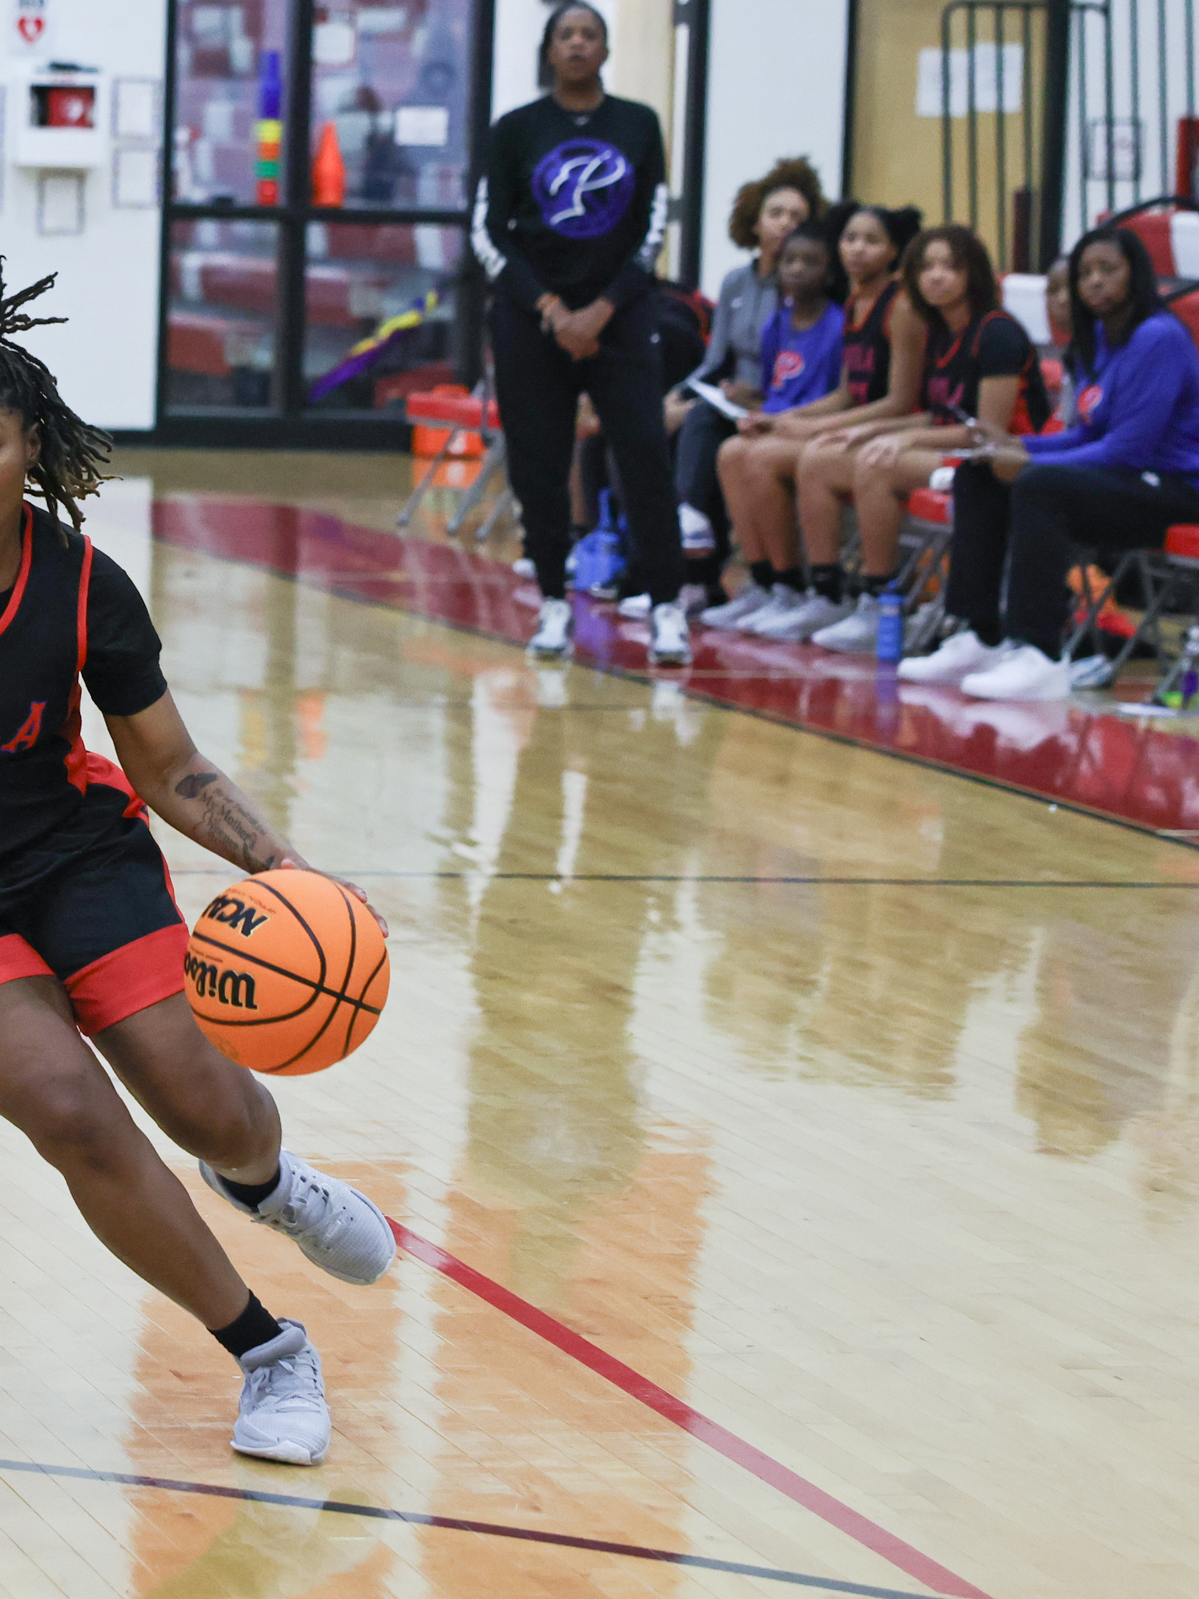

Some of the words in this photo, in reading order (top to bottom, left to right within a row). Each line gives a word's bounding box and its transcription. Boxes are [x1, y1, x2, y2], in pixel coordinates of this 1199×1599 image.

[548, 149, 626, 226] P
[772, 351, 805, 391] P
[184, 951, 258, 1011] Wilso
